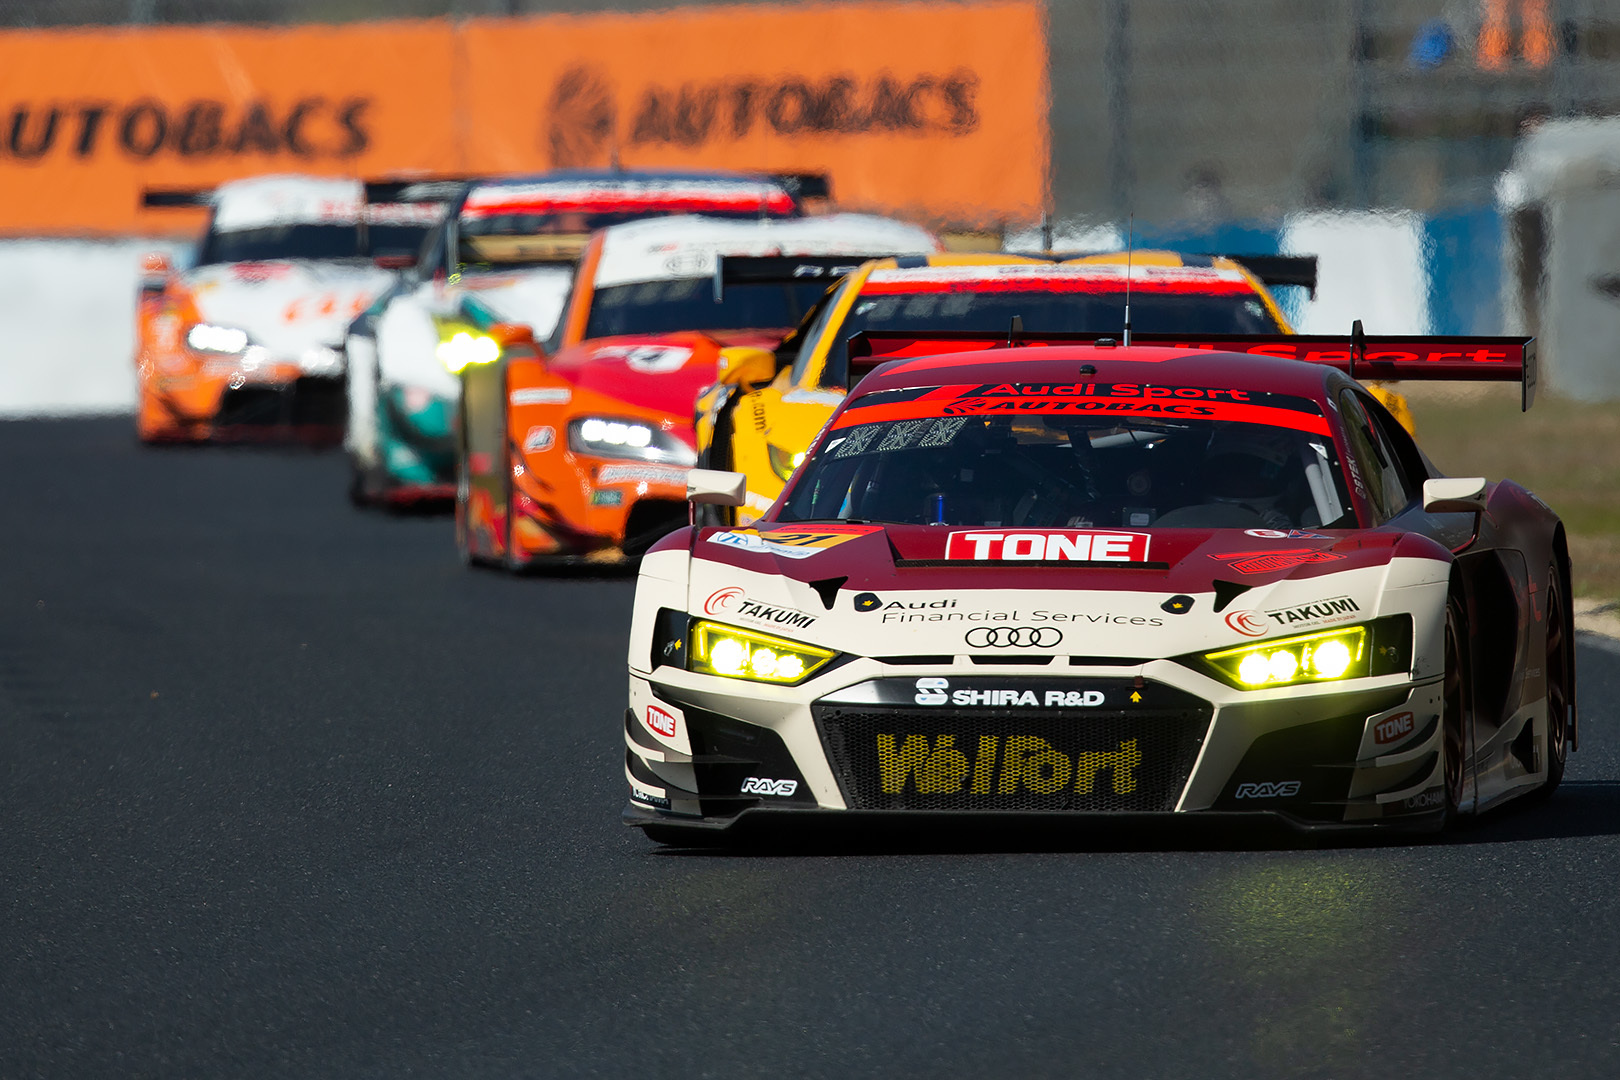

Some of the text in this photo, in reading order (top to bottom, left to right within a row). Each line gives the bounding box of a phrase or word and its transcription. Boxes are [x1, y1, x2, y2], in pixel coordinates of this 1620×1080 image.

[0, 100, 372, 158] UTOBACS
[981, 383, 1249, 401] Audi Sport
[992, 401, 1216, 415] AUTOBACS
[763, 534, 838, 546] 21
[964, 532, 1135, 562] TONE
[883, 599, 957, 610] Audi
[1267, 598, 1360, 625] TAKUMI
[737, 601, 816, 629] TAKUMI
[882, 610, 1164, 627] Financial Services
[952, 689, 1105, 707] SHIRA R&D
[648, 706, 674, 736] TONE
[1377, 714, 1412, 741] TONE
[741, 777, 798, 797] RAYS
[1235, 780, 1301, 799] RAYS
